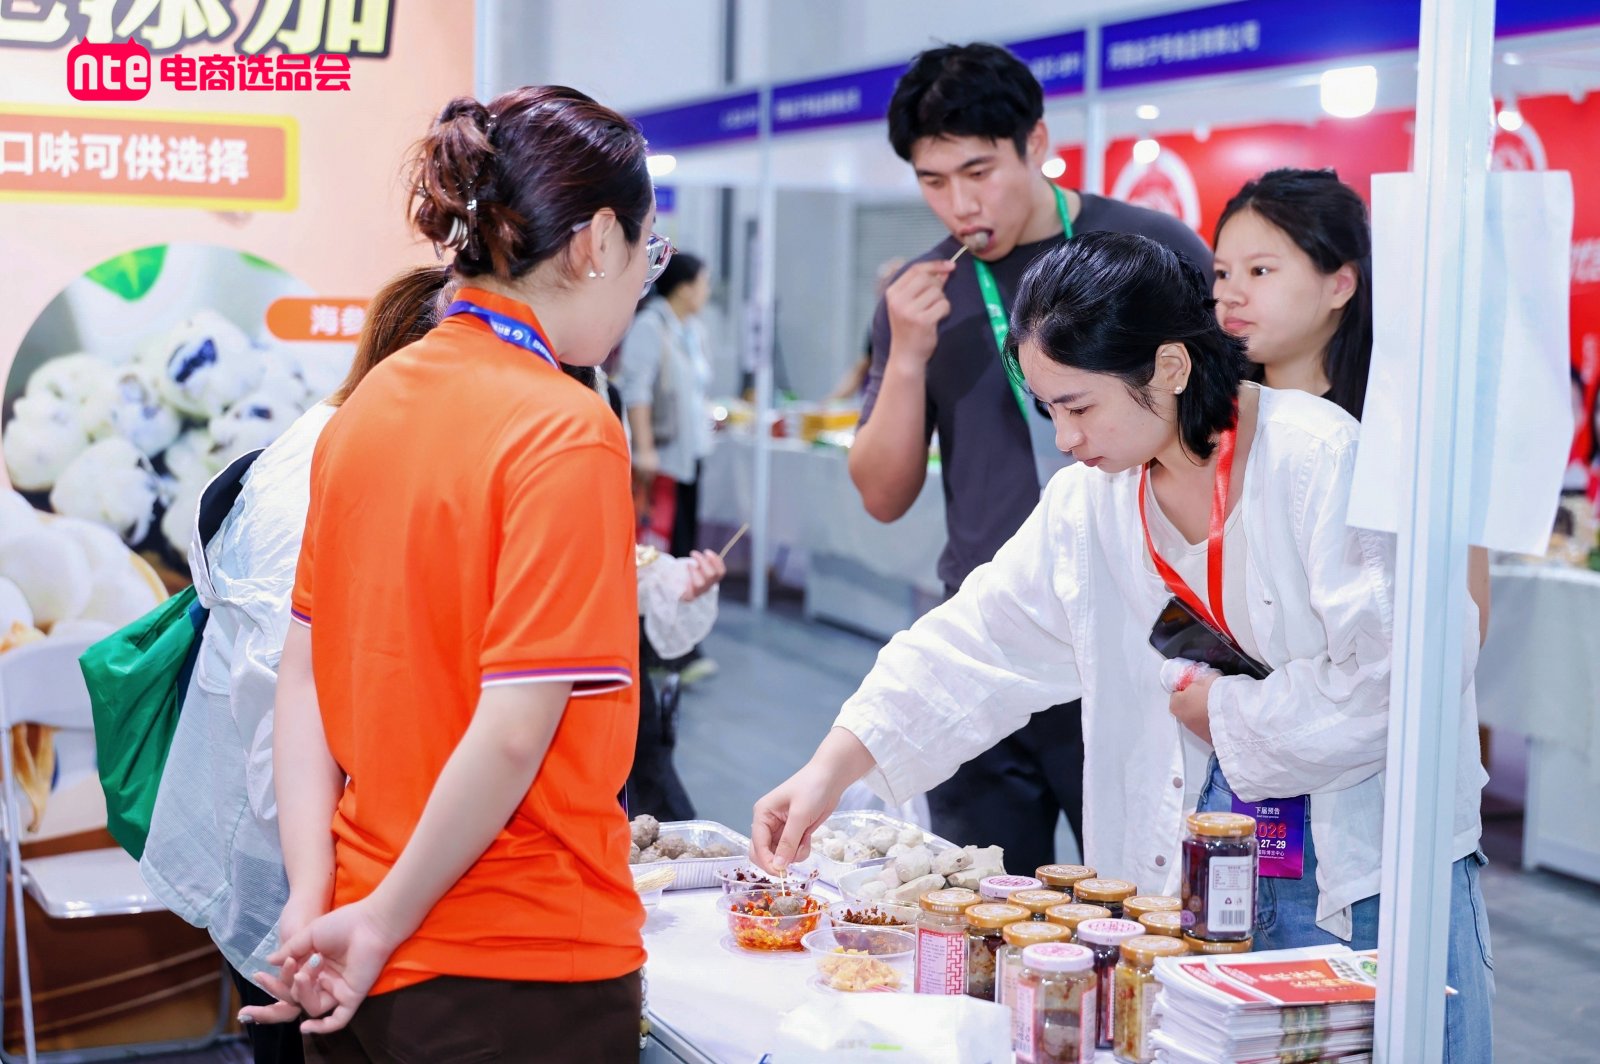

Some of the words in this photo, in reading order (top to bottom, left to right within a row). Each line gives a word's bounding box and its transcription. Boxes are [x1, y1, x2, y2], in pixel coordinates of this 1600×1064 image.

[0, 130, 250, 185] 口味可供选择
[1255, 806, 1280, 814] 下届预告
[1256, 823, 1287, 838] 026
